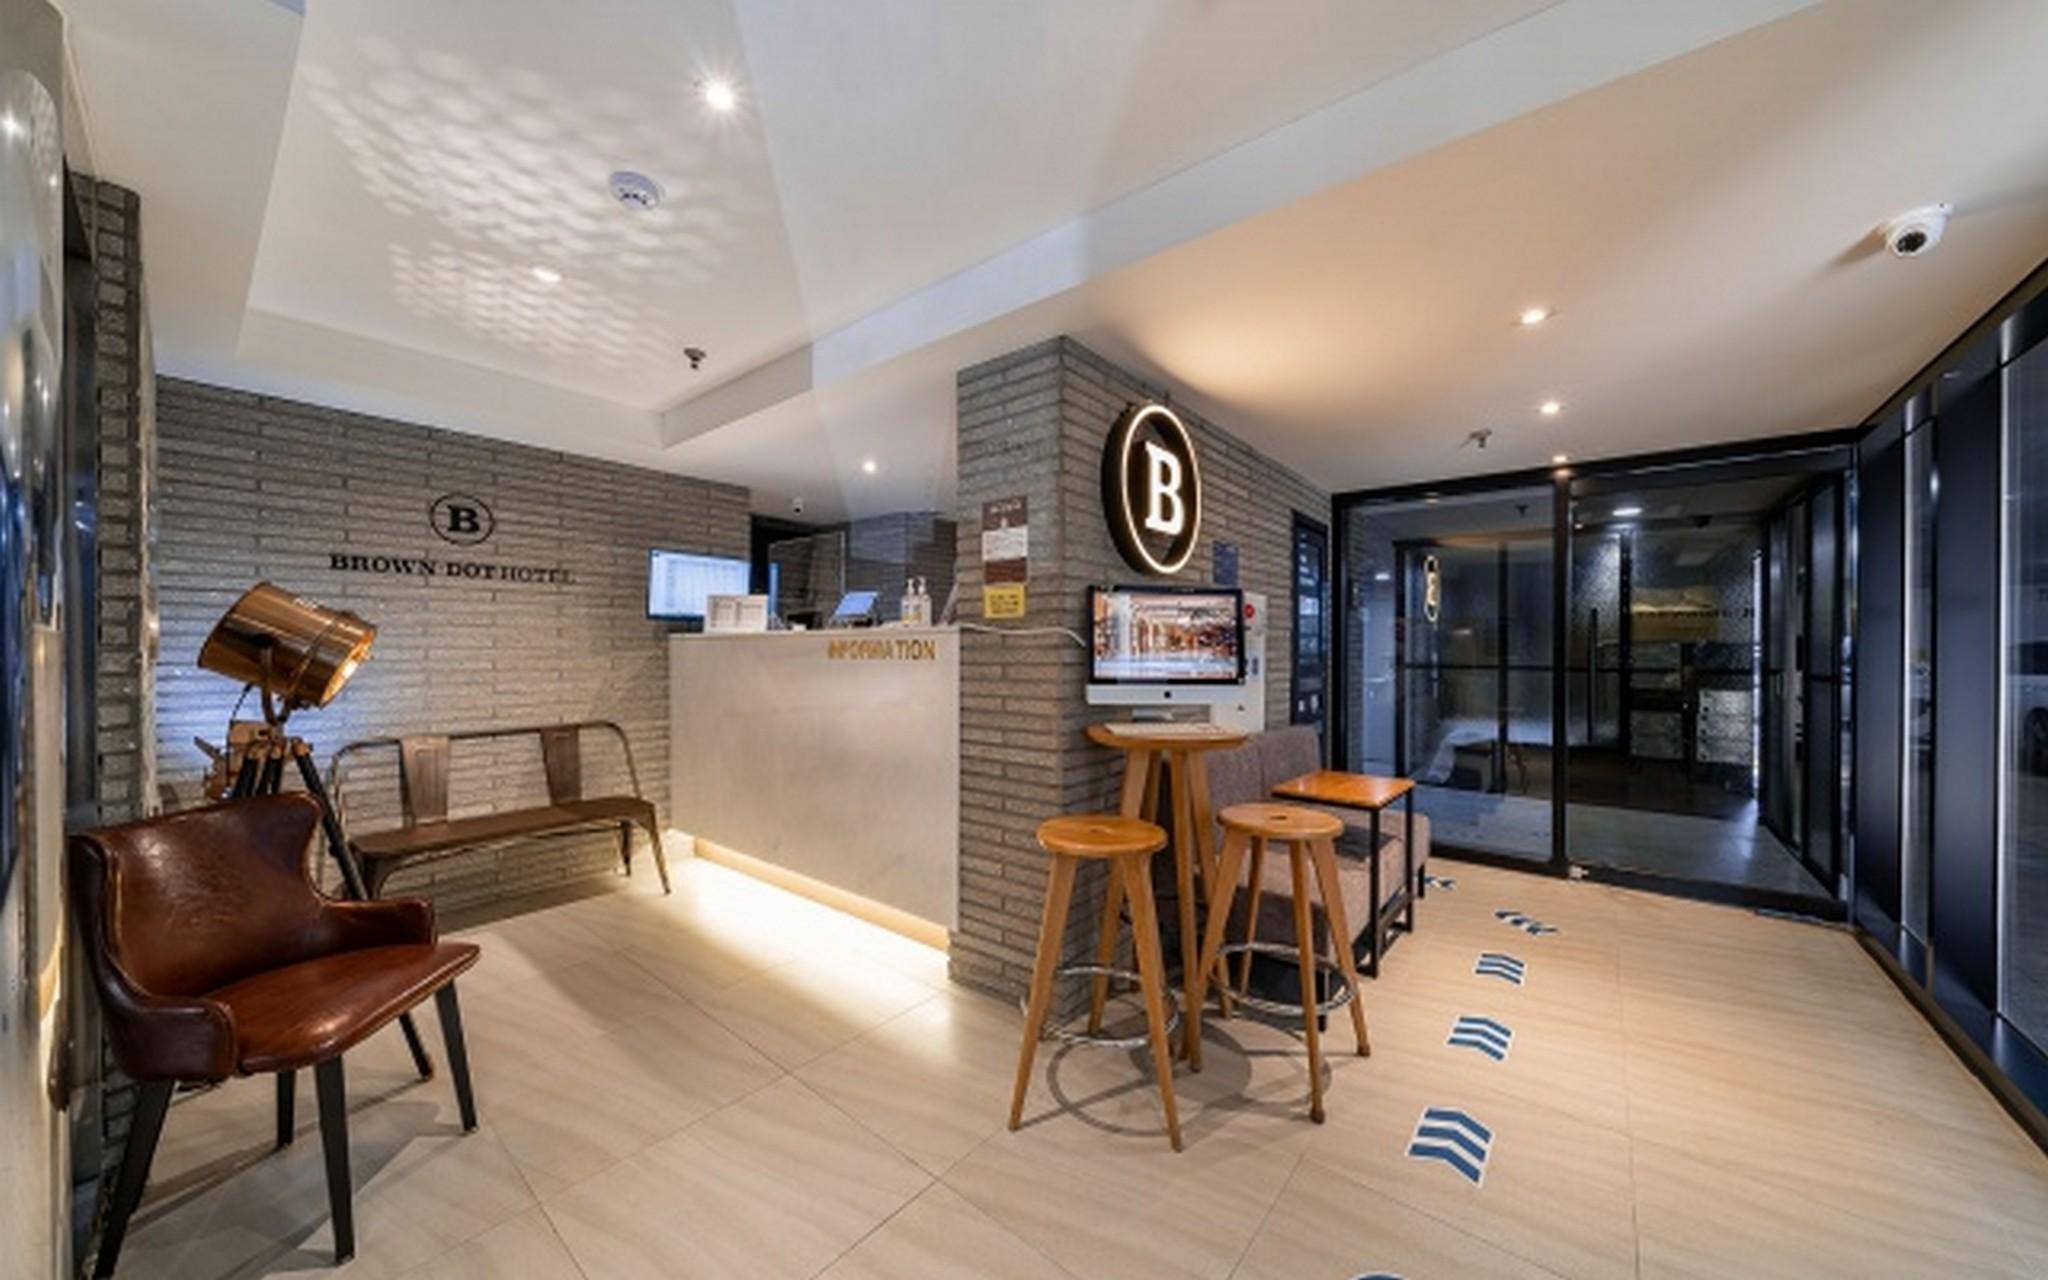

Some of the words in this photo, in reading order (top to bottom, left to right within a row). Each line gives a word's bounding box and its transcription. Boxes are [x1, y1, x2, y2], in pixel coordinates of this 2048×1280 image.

[1145, 440, 1184, 535] B
[446, 504, 480, 533] B
[329, 553, 436, 576] BROWN
[446, 562, 496, 580] DOT
[501, 565, 577, 585] HOTEL
[827, 639, 936, 661] INFORMATION
